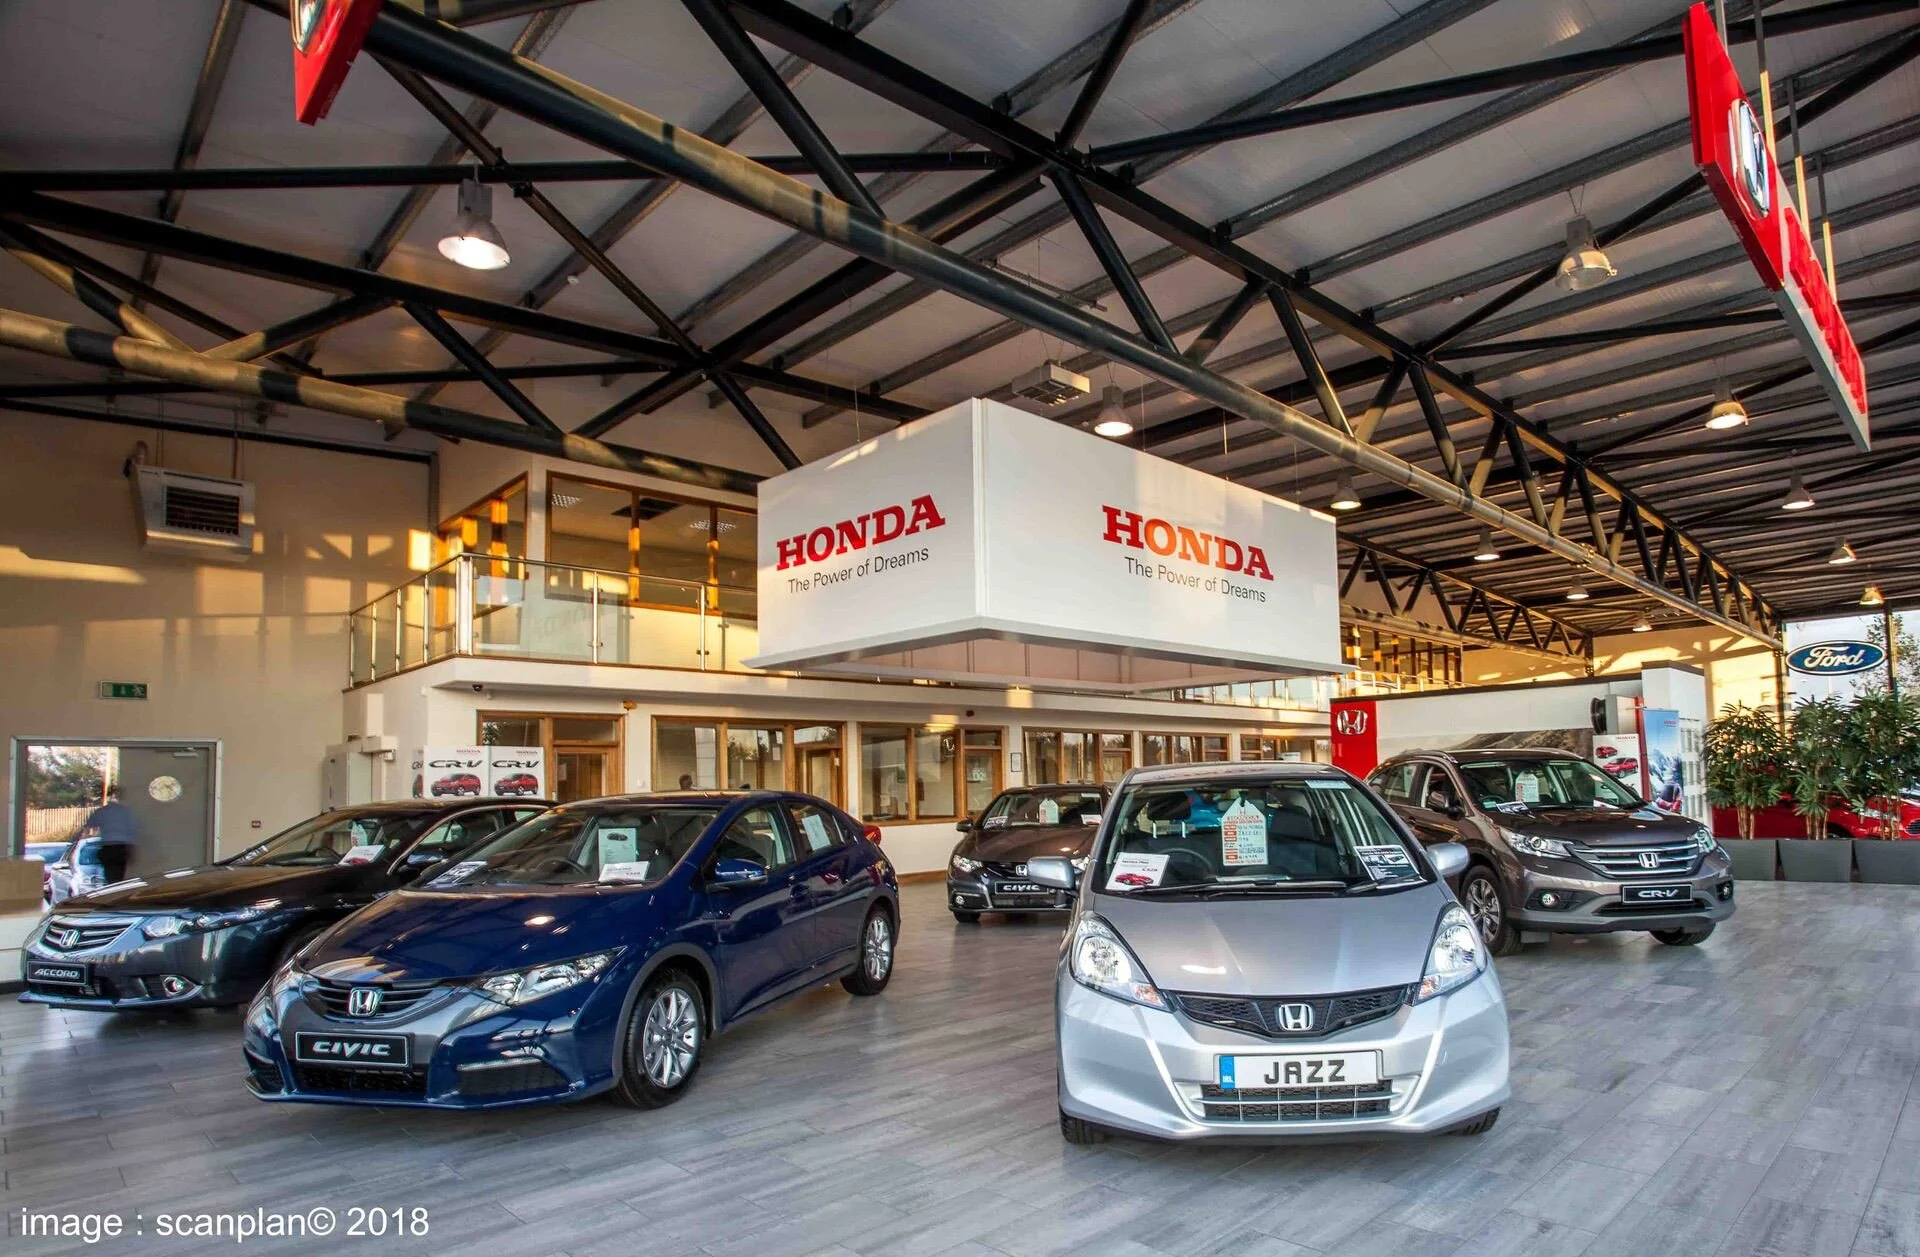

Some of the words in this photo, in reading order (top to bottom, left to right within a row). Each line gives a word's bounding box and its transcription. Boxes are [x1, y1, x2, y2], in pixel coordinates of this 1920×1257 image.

[776, 494, 946, 571] HONDA
[1102, 505, 1274, 581] HONDA
[788, 578, 810, 594] The
[814, 567, 852, 588] Power
[857, 559, 870, 577] of
[874, 547, 929, 573] Dreams
[1124, 556, 1153, 578] The
[1158, 564, 1201, 589] Power
[1205, 577, 1217, 592] of
[1221, 579, 1266, 602] Dreams
[1803, 646, 1866, 668] Ford
[429, 760, 483, 768] CR-V
[491, 760, 540, 768] CR-V
[1002, 884, 1041, 892] CIVIC
[1638, 889, 1679, 898] CR-V
[34, 968, 80, 979] ACCORD
[312, 1041, 391, 1058] CIVIC
[1263, 1059, 1345, 1084] JAZZ
